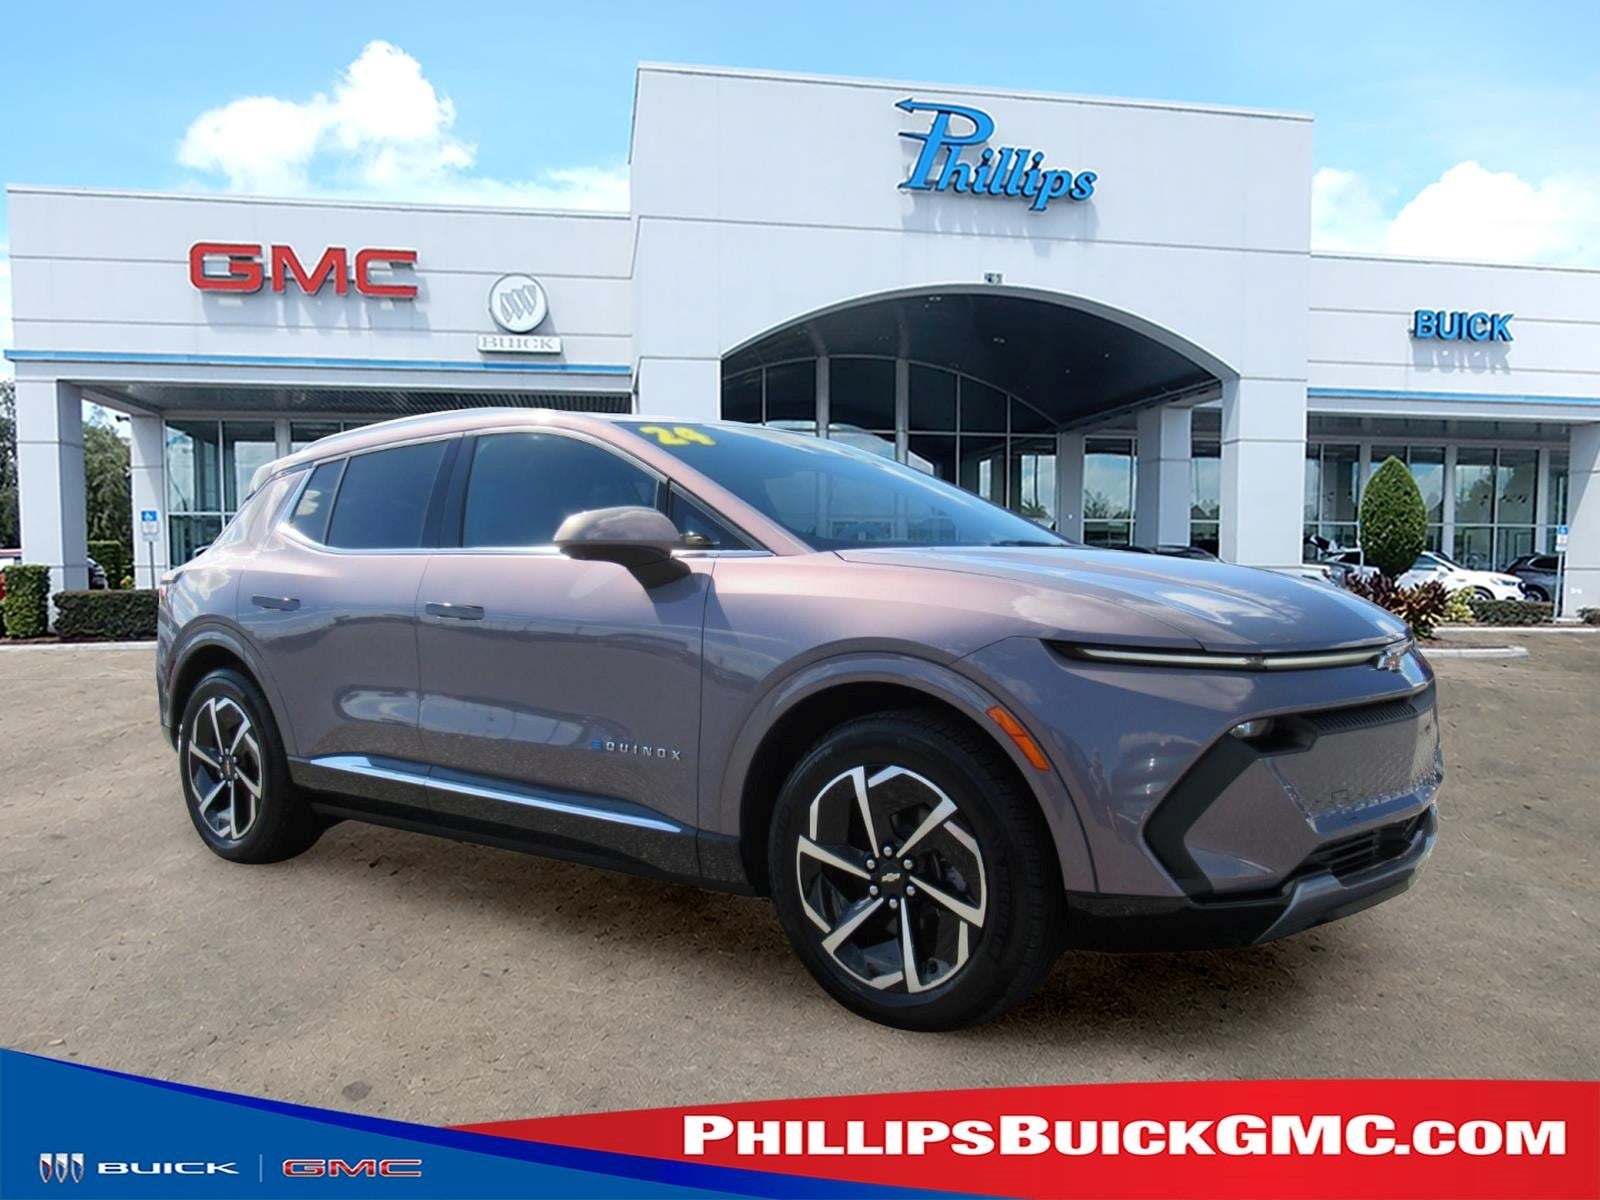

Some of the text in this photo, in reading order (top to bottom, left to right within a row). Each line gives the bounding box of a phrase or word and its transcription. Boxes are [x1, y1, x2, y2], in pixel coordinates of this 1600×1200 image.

[896, 98, 1097, 212] Phillips
[189, 242, 418, 298] GMC
[1414, 309, 1514, 342] BUICK
[482, 336, 555, 350] BUICK
[639, 426, 717, 446] 24
[591, 739, 681, 761] EQUINOX
